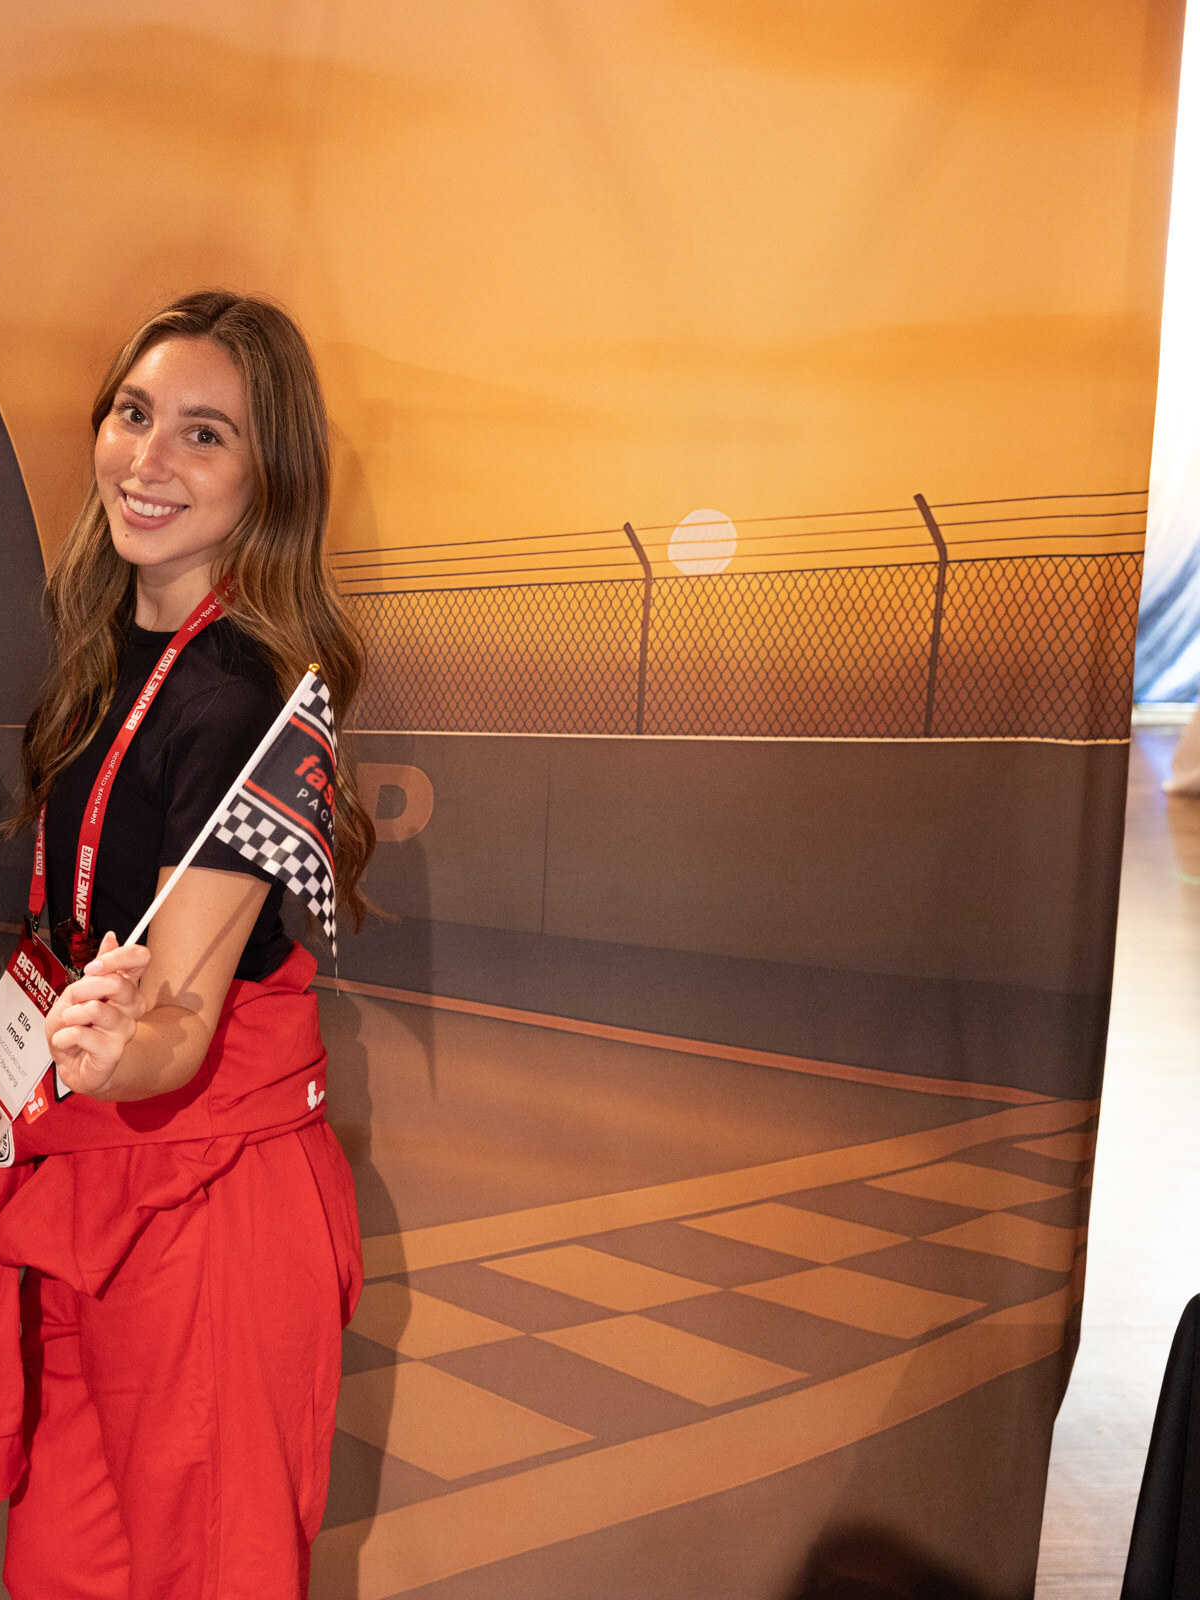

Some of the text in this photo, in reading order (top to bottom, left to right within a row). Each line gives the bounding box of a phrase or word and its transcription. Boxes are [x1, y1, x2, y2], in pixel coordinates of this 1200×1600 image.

[187, 617, 202, 632] New
[200, 604, 216, 618] York
[100, 770, 112, 787] City
[94, 787, 104, 806] York
[90, 805, 99, 825] New
[79, 845, 94, 871] LIVE
[13, 964, 49, 1012] New York City
[17, 1012, 32, 1032] Ella
[6, 1022, 25, 1050] Imola
